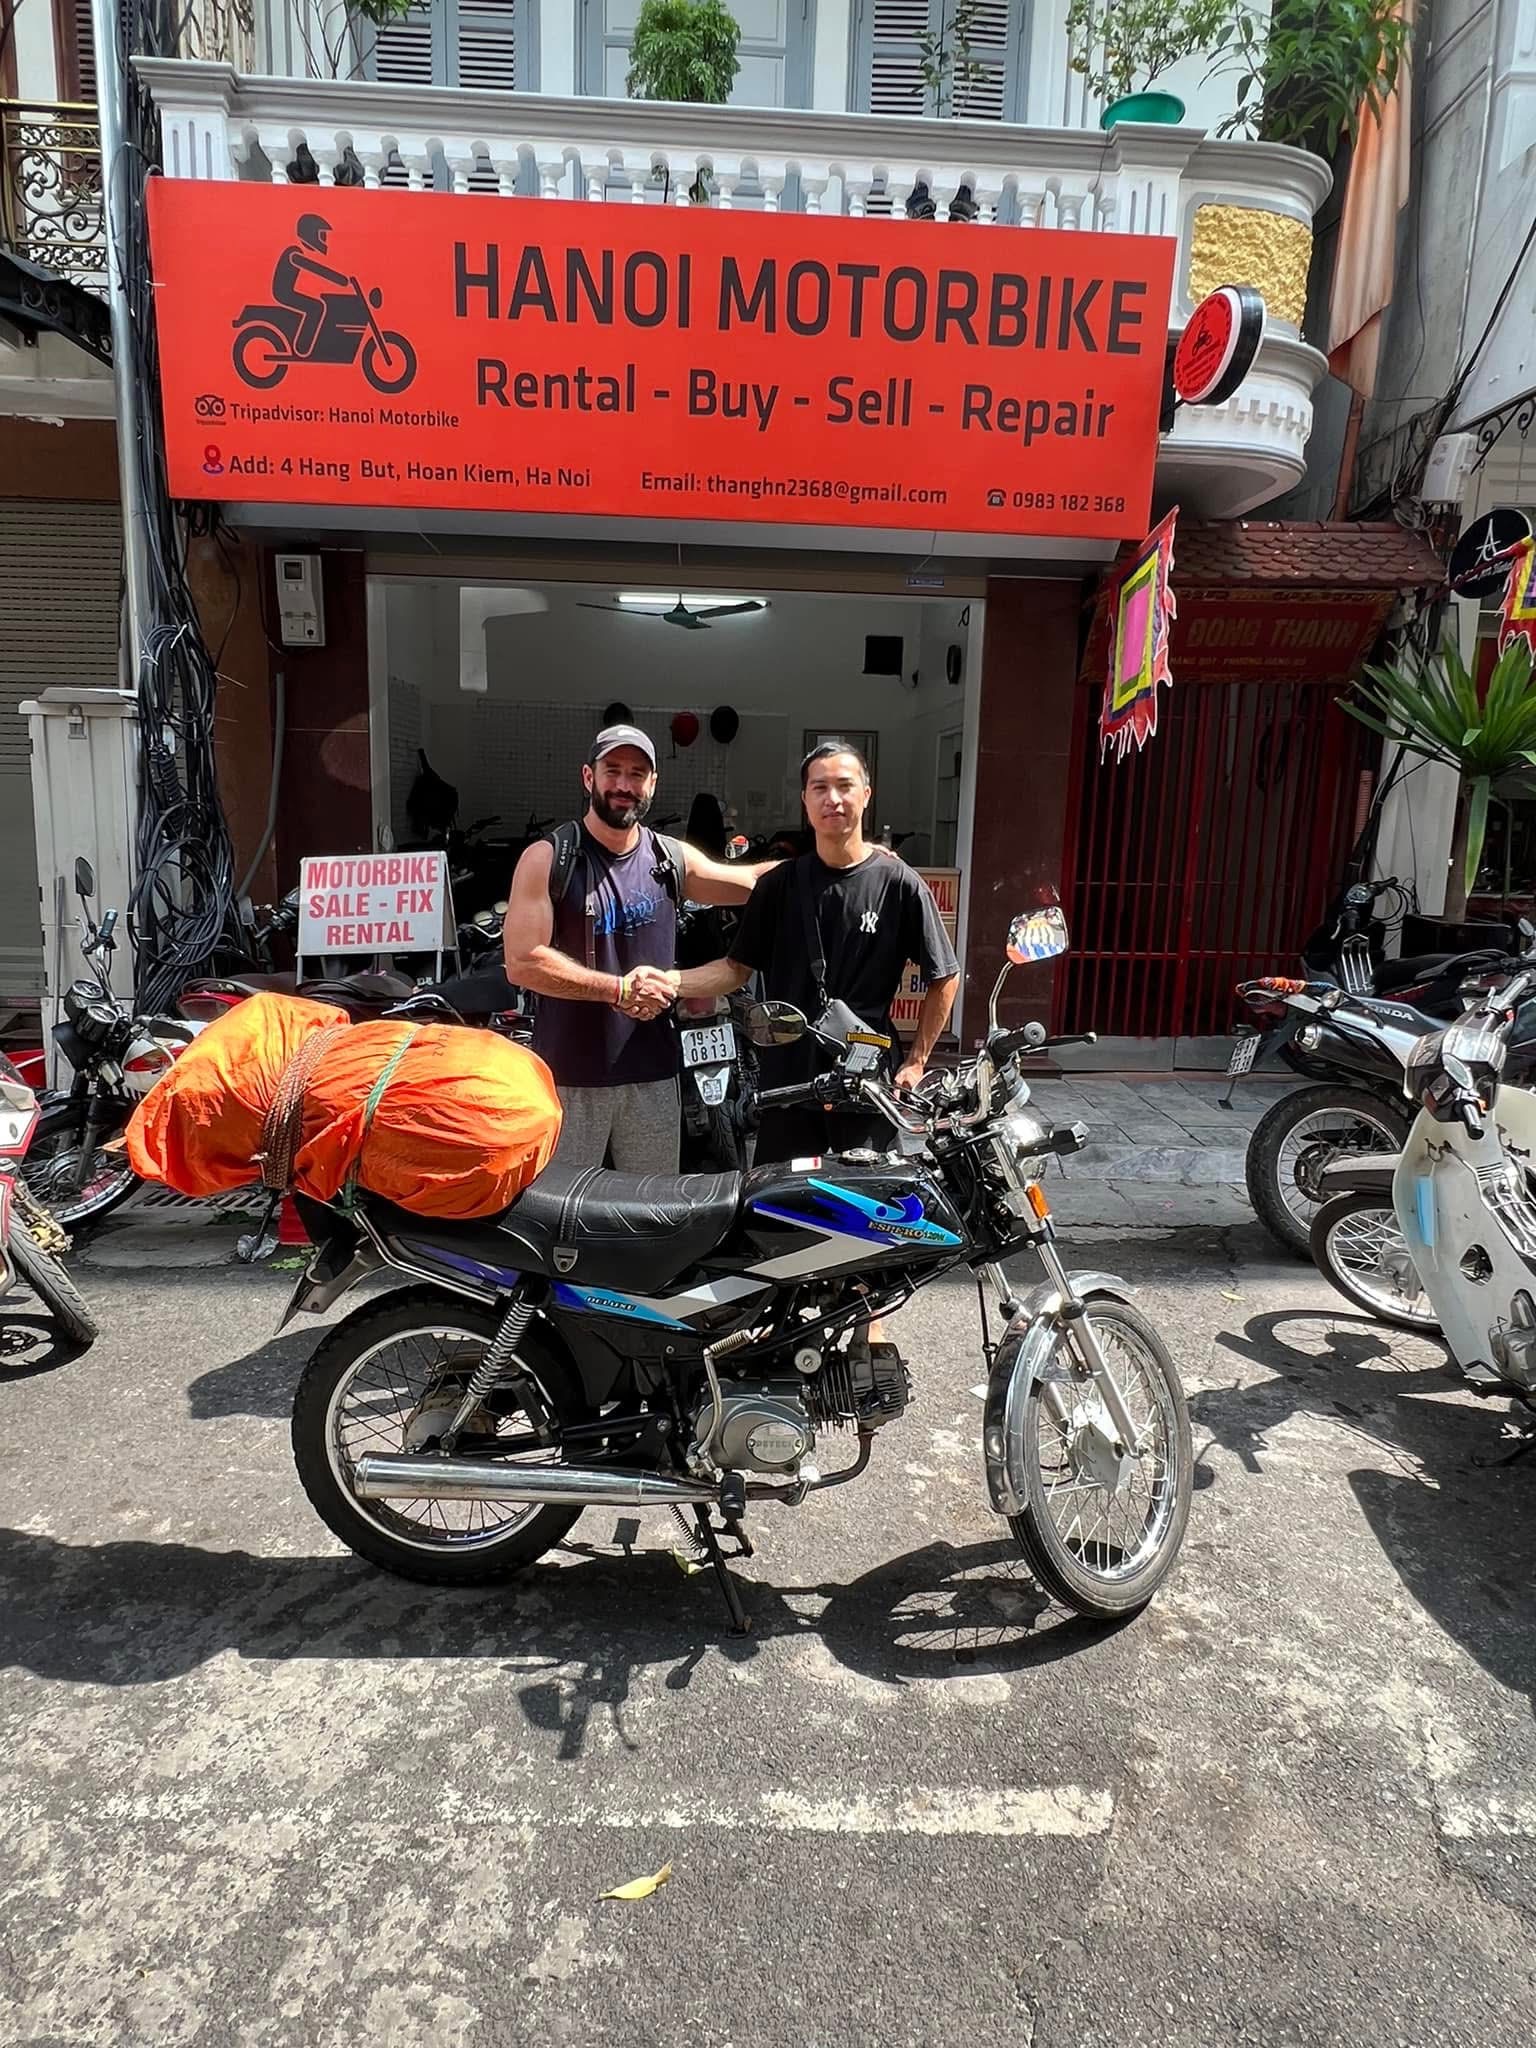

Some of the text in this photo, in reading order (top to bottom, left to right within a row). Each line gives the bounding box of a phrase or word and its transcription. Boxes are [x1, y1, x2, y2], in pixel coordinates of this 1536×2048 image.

[454, 242, 691, 328] HANOI
[718, 256, 1148, 355] MOTORBIKE
[230, 403, 325, 425] Tripadvisor:
[329, 407, 375, 425] Hanoi
[379, 409, 459, 427] Motorbike
[477, 359, 635, 413] Rental
[689, 368, 779, 432] Buy
[827, 376, 912, 426] Sell
[962, 384, 1115, 447] Repair
[229, 455, 591, 487] Add: 4 Hang But, Hoan Kiem, Ha Noi
[641, 471, 947, 504] Email: thanghn2368@gmail.com
[1013, 492, 1125, 513] 0983 182 368
[306, 856, 438, 889] MOTORBIKE
[309, 893, 370, 919] SALE
[396, 889, 434, 914] FIX
[327, 921, 415, 946] RENTAL
[691, 1044, 727, 1062] 0813
